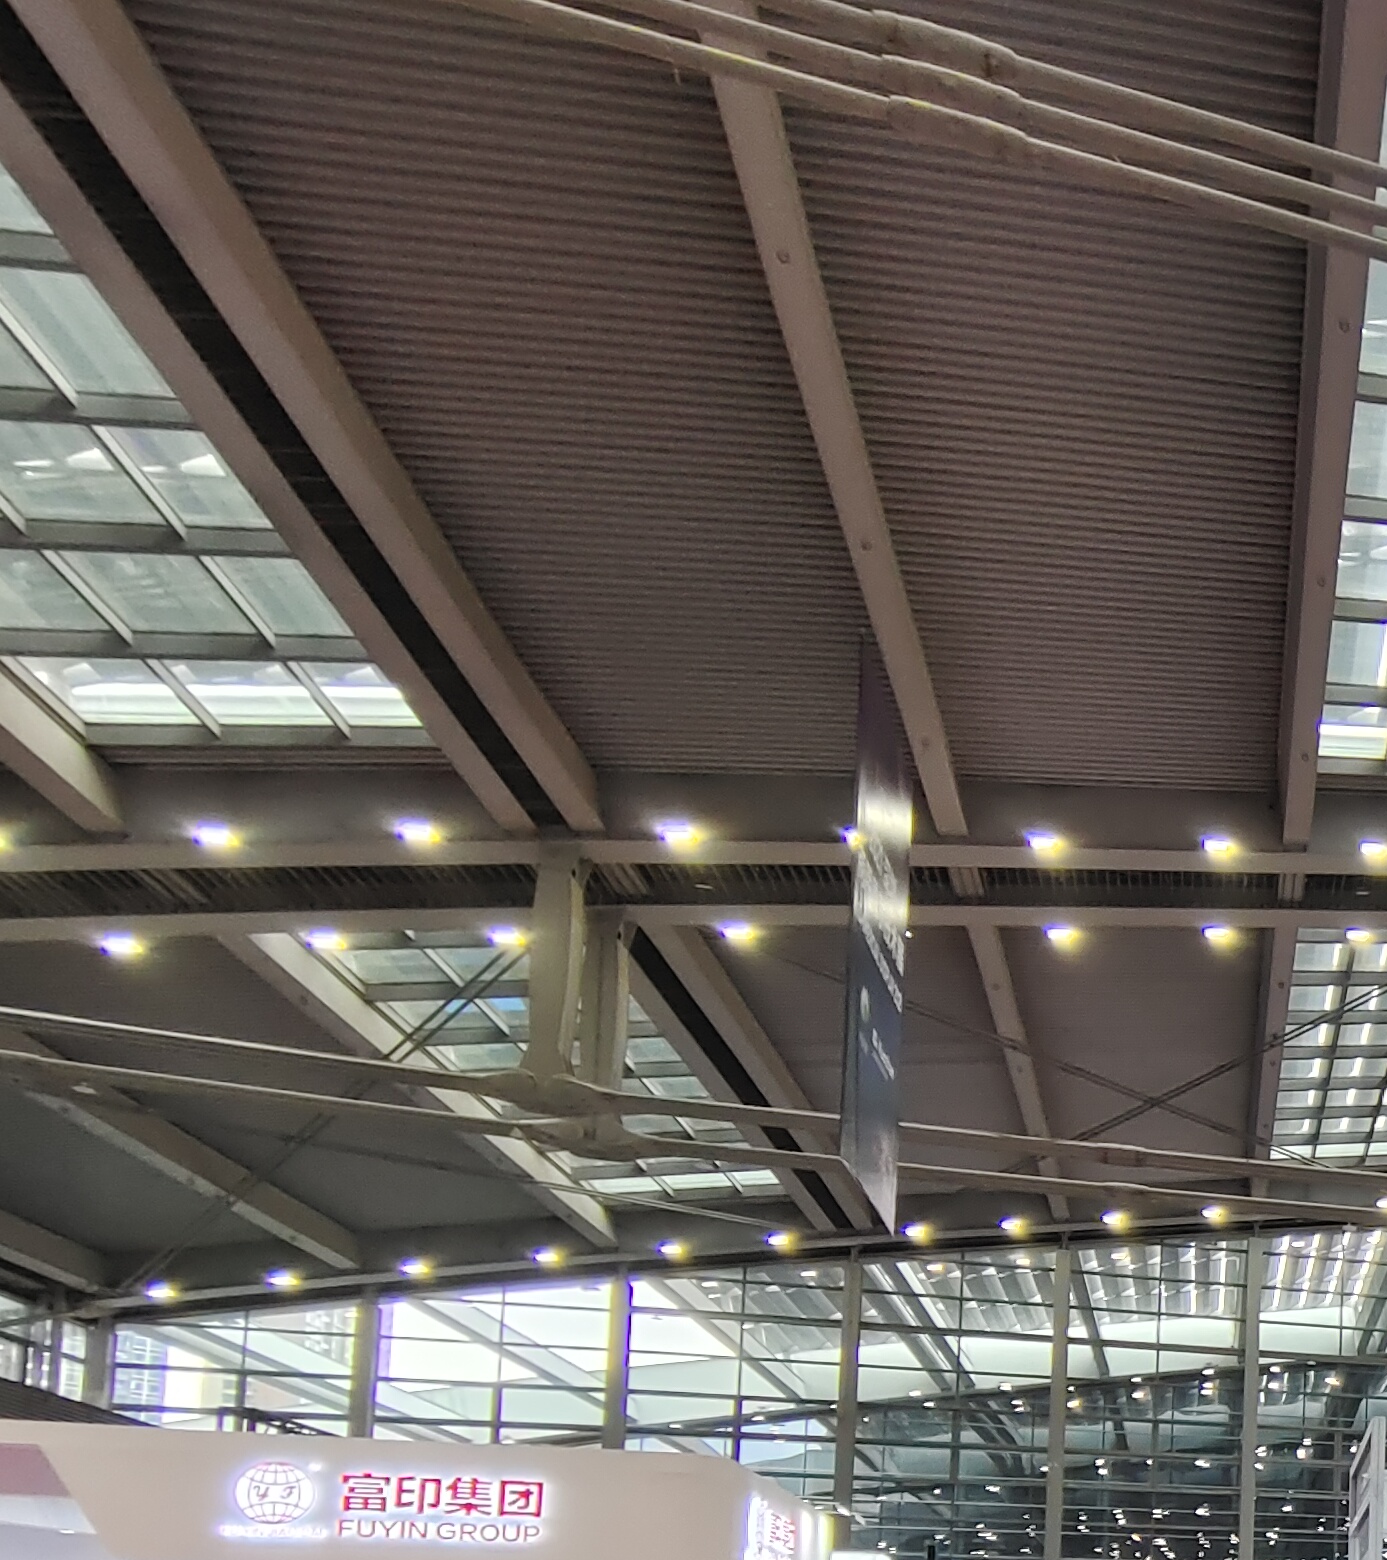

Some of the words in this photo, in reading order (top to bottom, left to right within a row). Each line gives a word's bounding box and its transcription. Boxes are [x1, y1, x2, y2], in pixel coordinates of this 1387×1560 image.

[340, 1472, 545, 1519] 富印集团
[338, 1519, 428, 1539] FUYIN
[437, 1523, 541, 1543] GROUP
